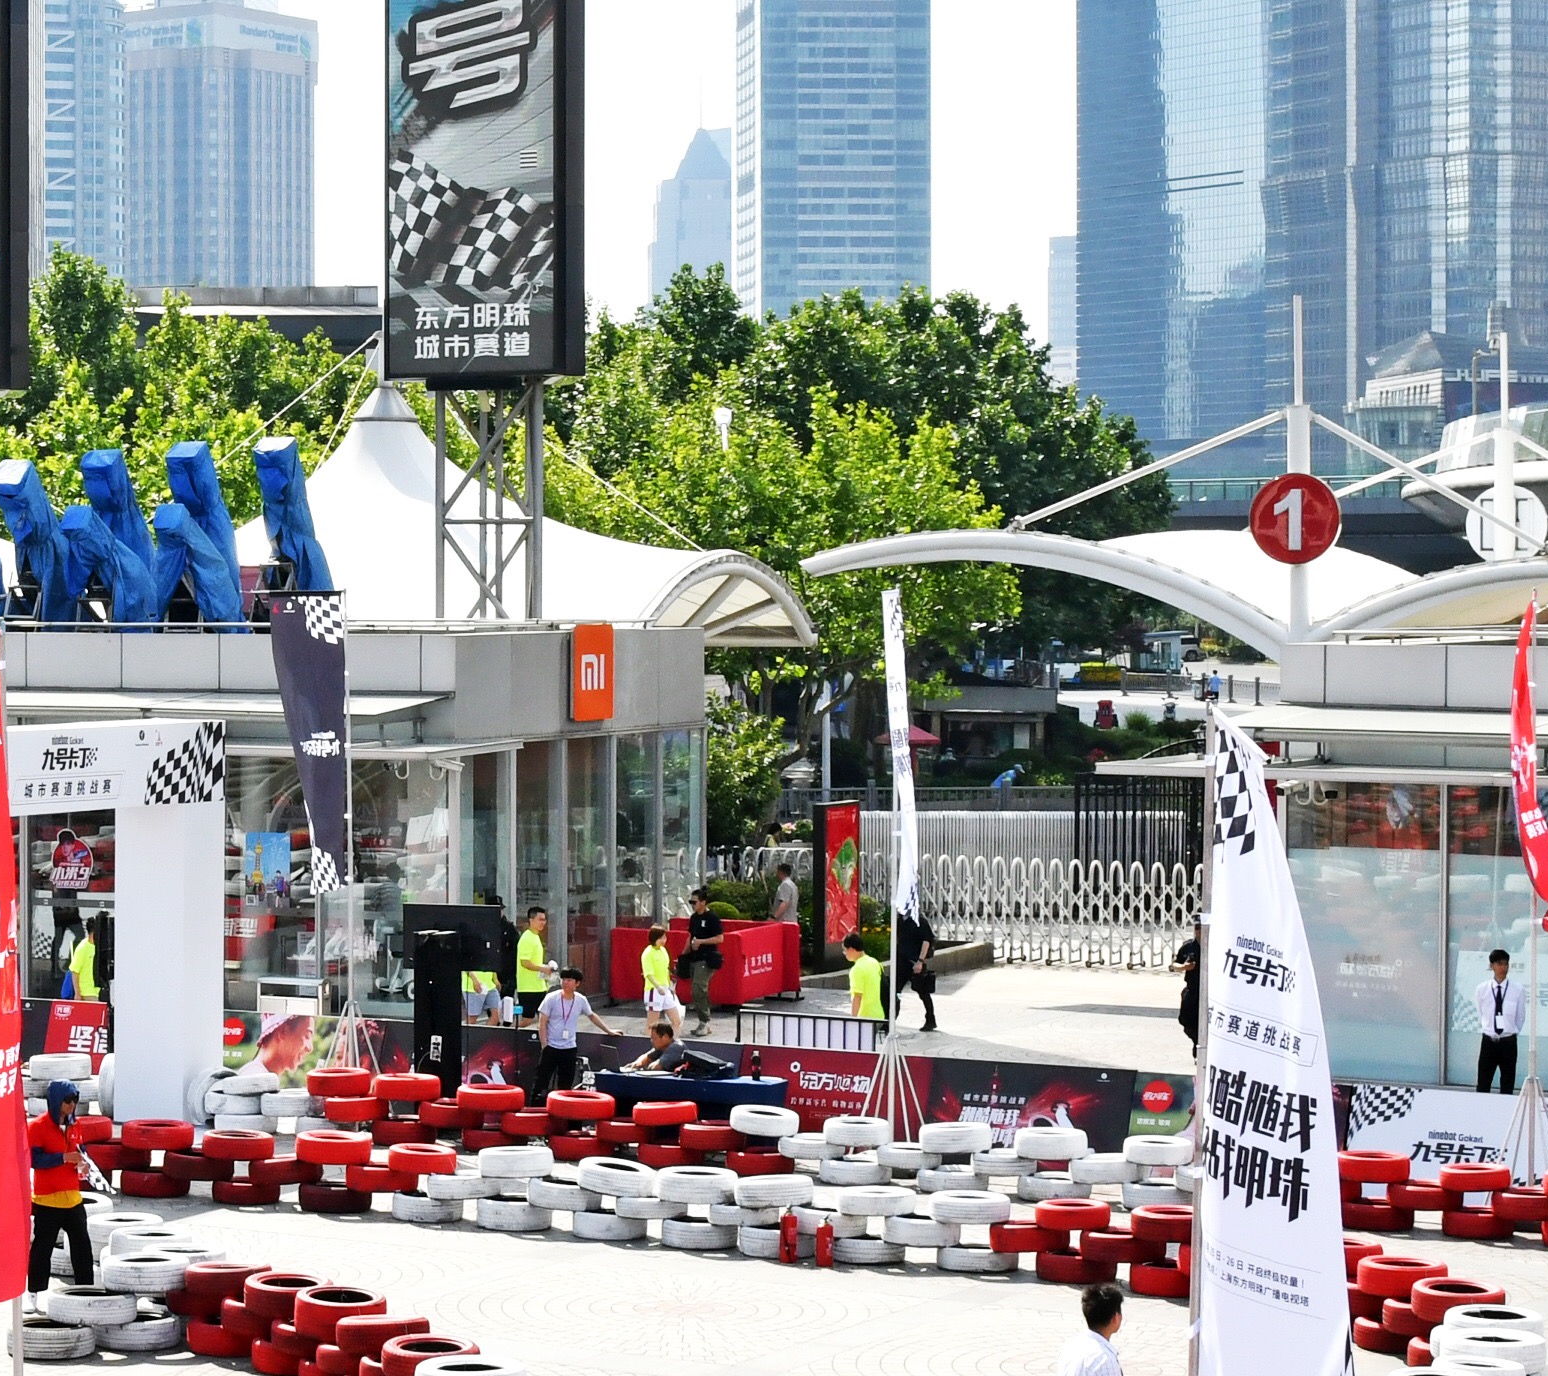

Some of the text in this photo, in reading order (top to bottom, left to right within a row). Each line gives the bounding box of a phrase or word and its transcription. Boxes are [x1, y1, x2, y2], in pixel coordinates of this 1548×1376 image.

[415, 303, 531, 331] 东方明珠
[415, 334, 531, 359] 城市赛道
[1273, 489, 1302, 551] 1
[41, 747, 90, 770] 九号卡丁
[24, 778, 112, 798] 城市赛道挑战赛
[1237, 935, 1265, 954] ninebot
[1224, 949, 1288, 993] 九号卡丁
[1428, 1130, 1456, 1143] ninebot
[1410, 1142, 1490, 1166] 九号卡丁
